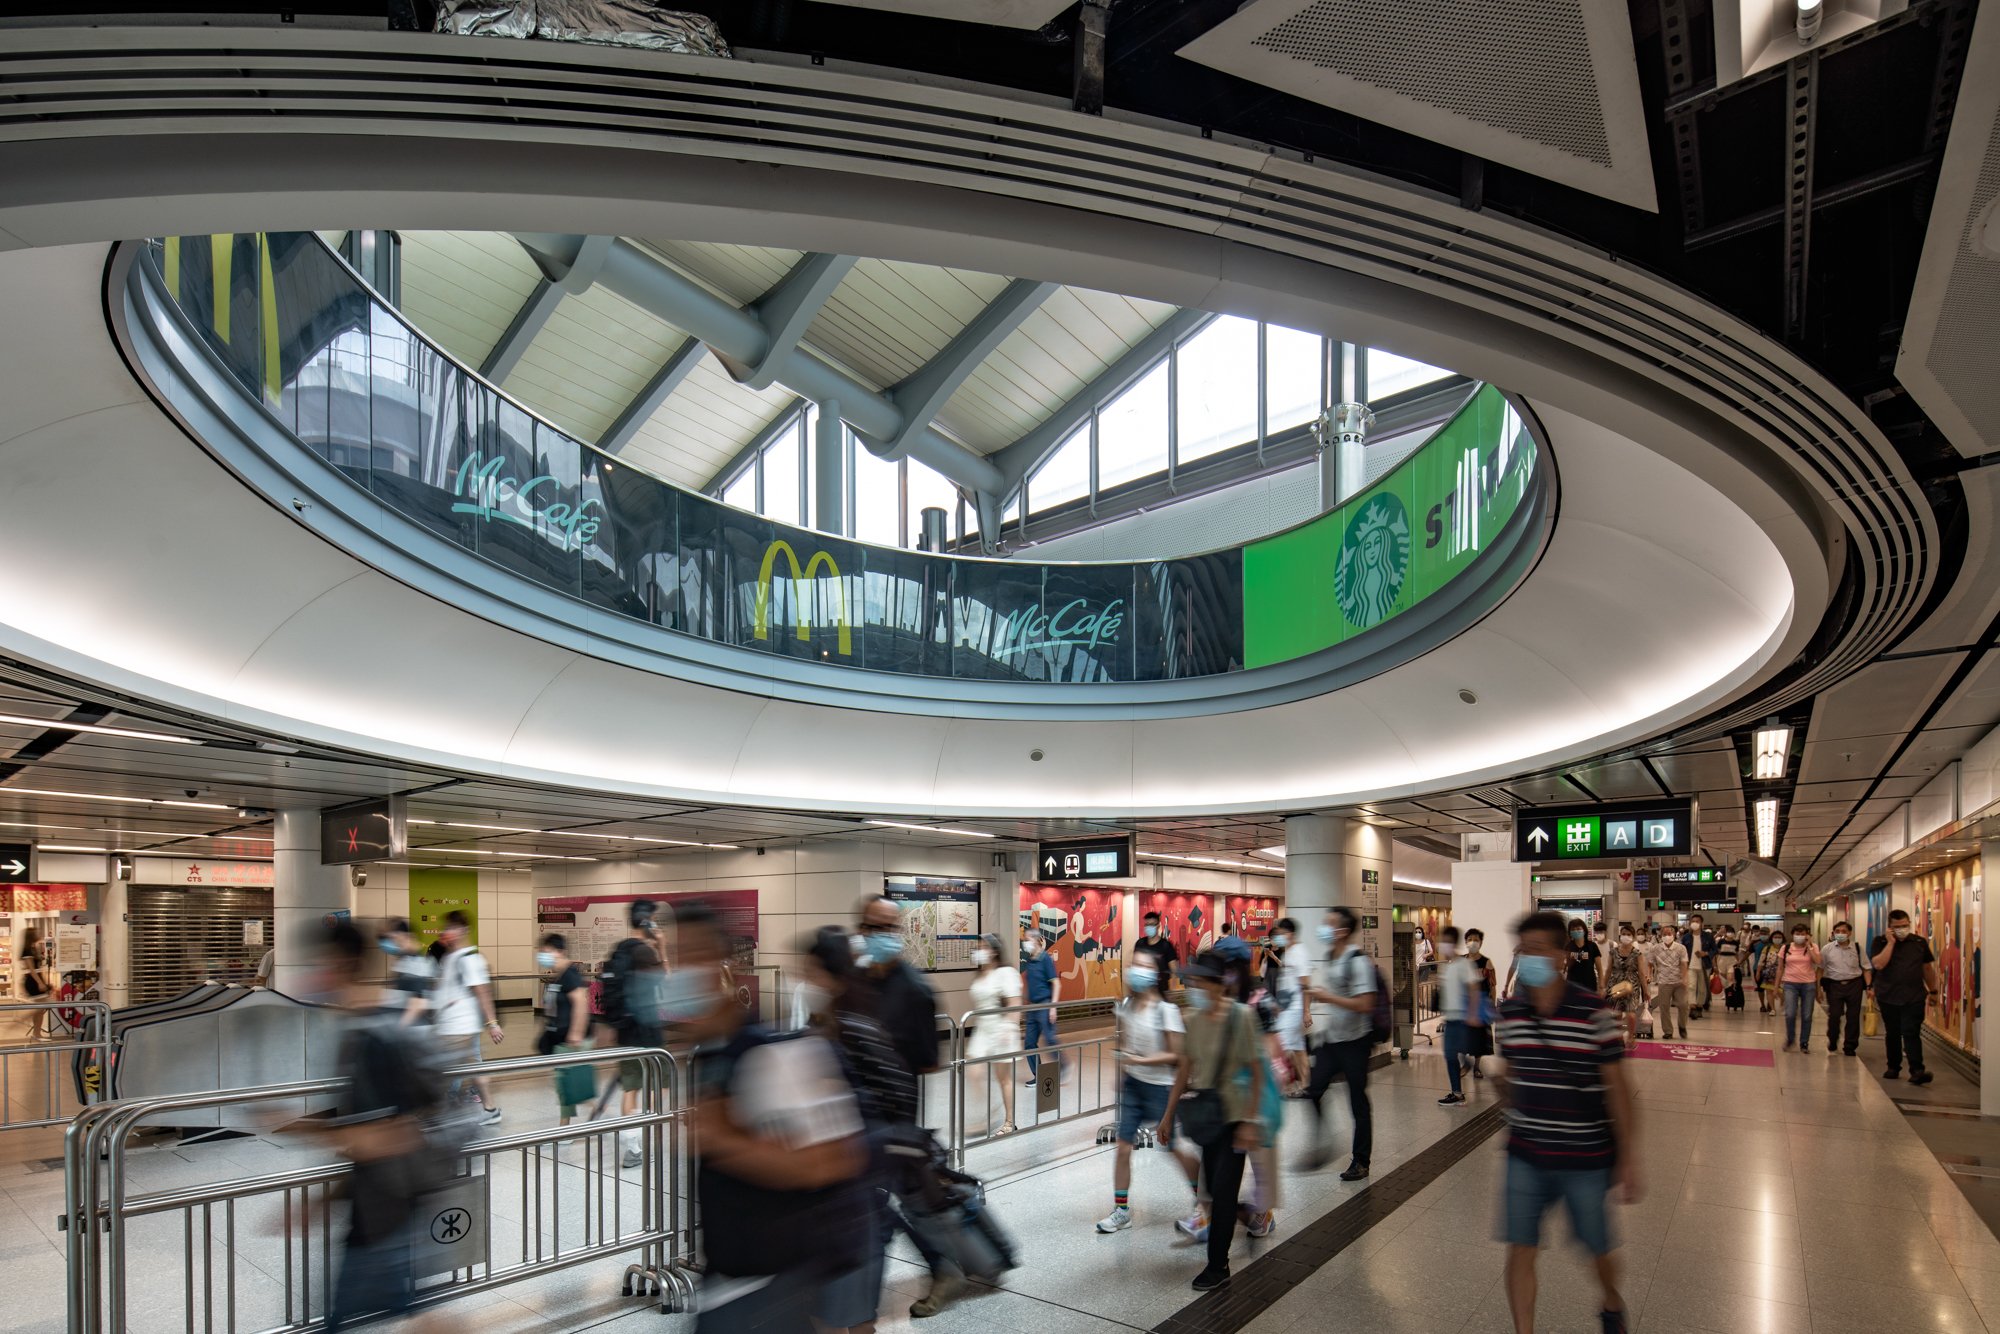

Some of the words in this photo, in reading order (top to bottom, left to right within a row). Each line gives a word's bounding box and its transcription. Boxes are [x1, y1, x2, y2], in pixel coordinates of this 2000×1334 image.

[452, 450, 601, 553] McCafé
[1002, 598, 1124, 653] McCafé
[1566, 822, 1591, 844] 出
[1613, 826, 1630, 846] A
[1649, 824, 1668, 844] D
[1566, 843, 1591, 852] EXIT
